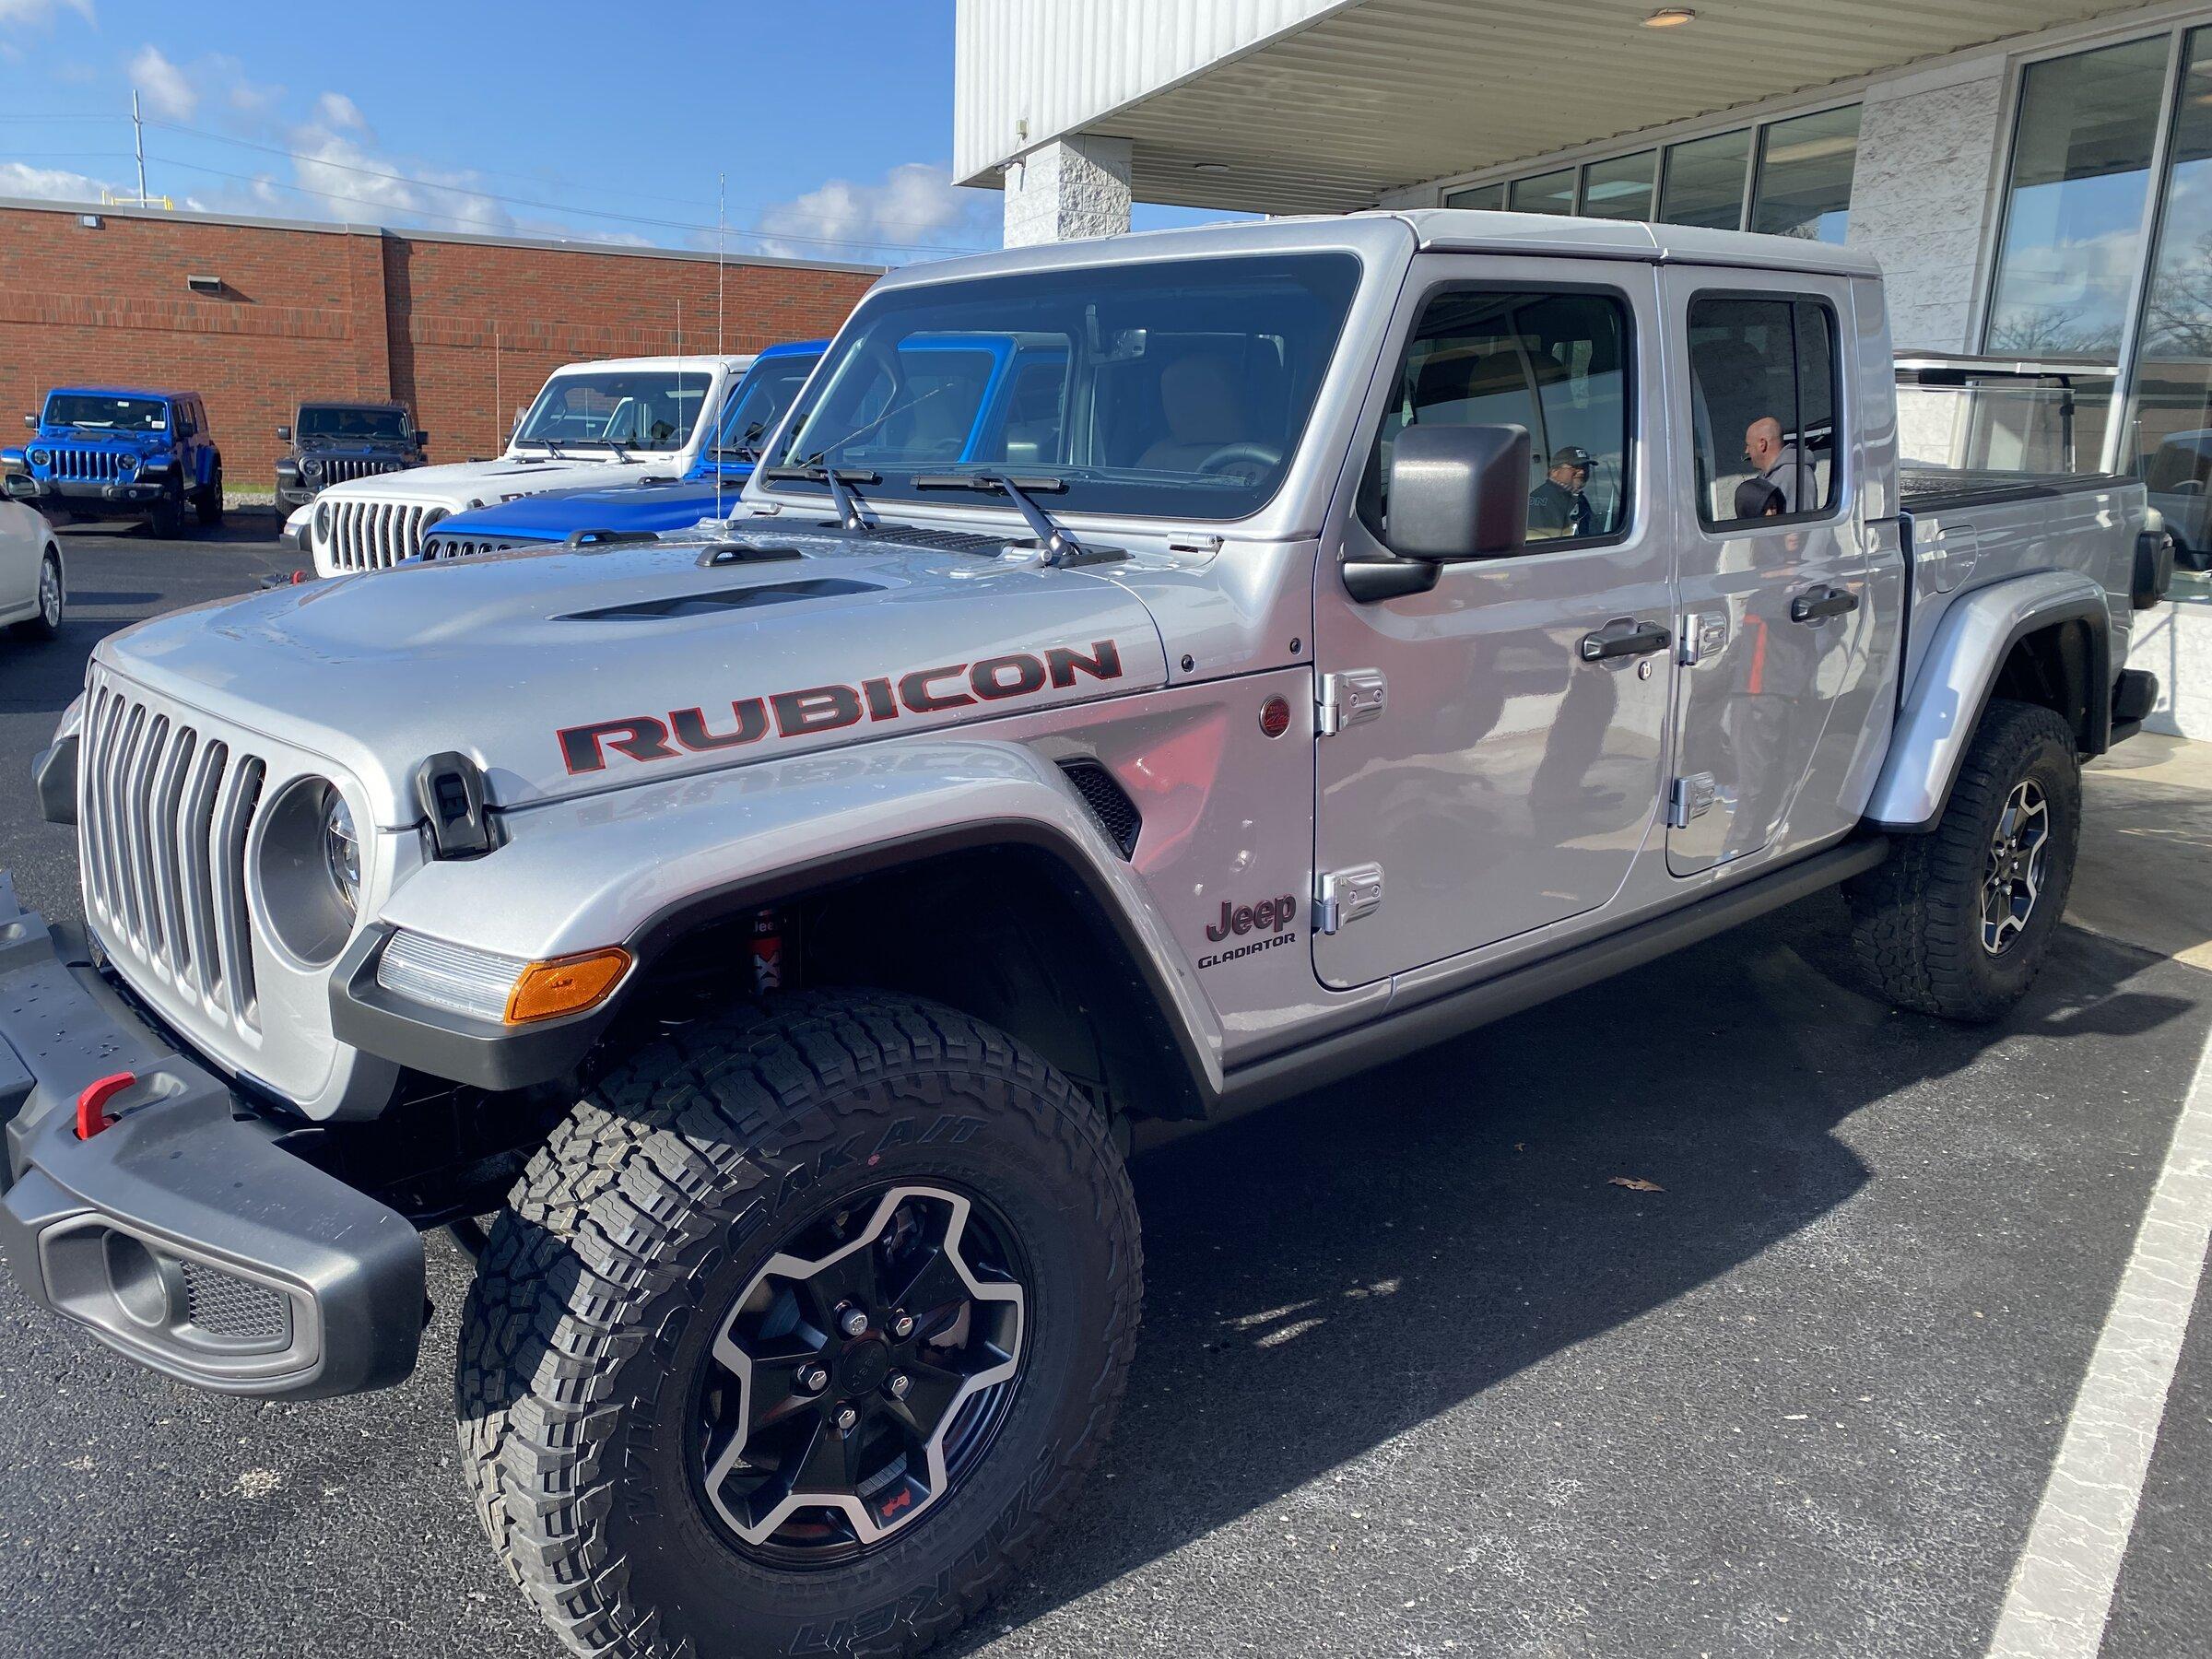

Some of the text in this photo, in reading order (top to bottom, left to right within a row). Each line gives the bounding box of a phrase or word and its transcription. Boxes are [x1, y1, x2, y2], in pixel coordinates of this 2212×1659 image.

[556, 640, 1123, 775] RUBICON
[754, 921, 778, 933] Jee
[1206, 893, 1297, 942] Jeep
[1198, 933, 1297, 970] GLADIATOR
